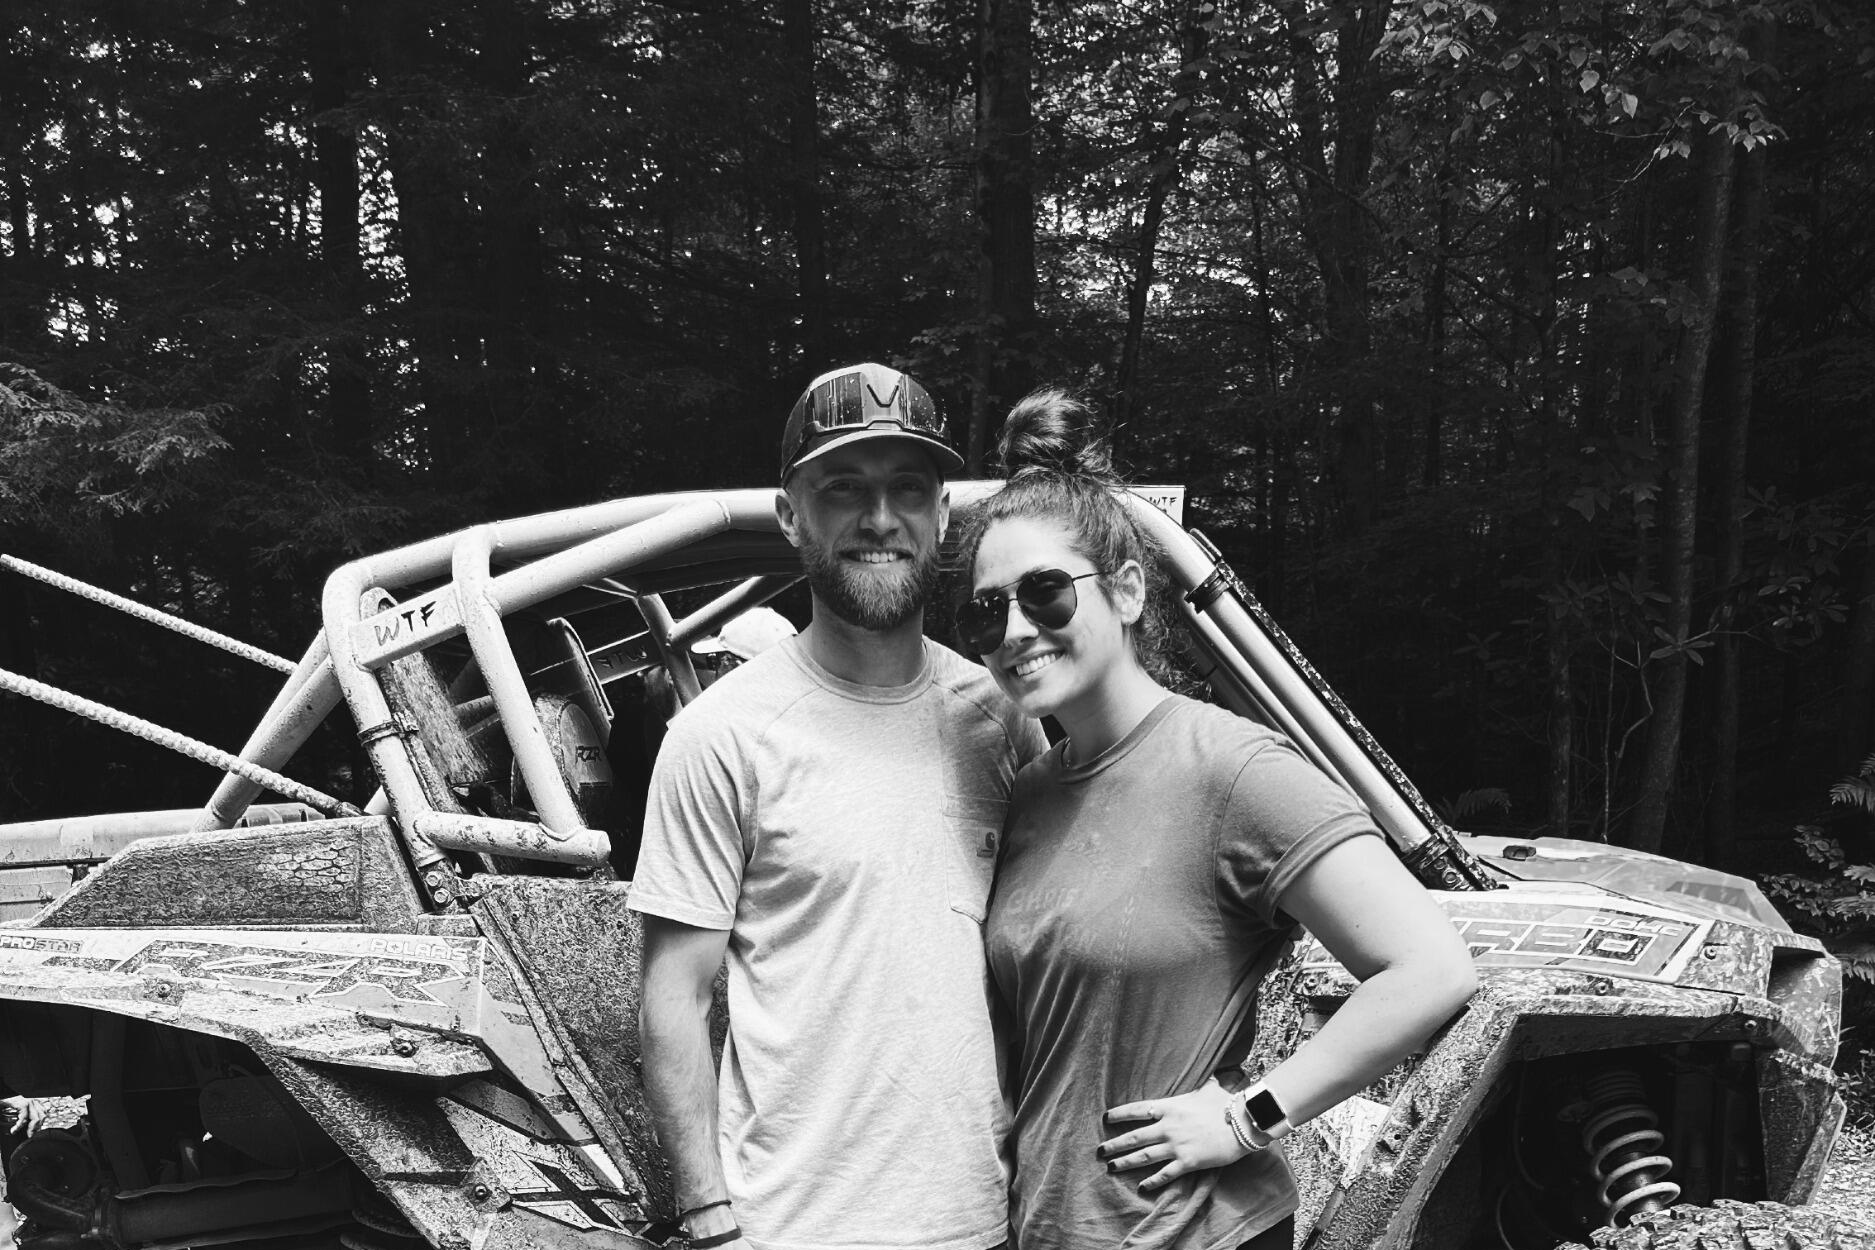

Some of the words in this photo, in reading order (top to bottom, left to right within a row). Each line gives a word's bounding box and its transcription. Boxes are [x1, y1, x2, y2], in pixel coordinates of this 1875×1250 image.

[1149, 496, 1177, 507] WTF
[374, 601, 437, 646] WTF
[1584, 914, 1682, 937] DOHC
[0, 934, 83, 953] PROSTAR
[370, 938, 468, 961] POLARIS
